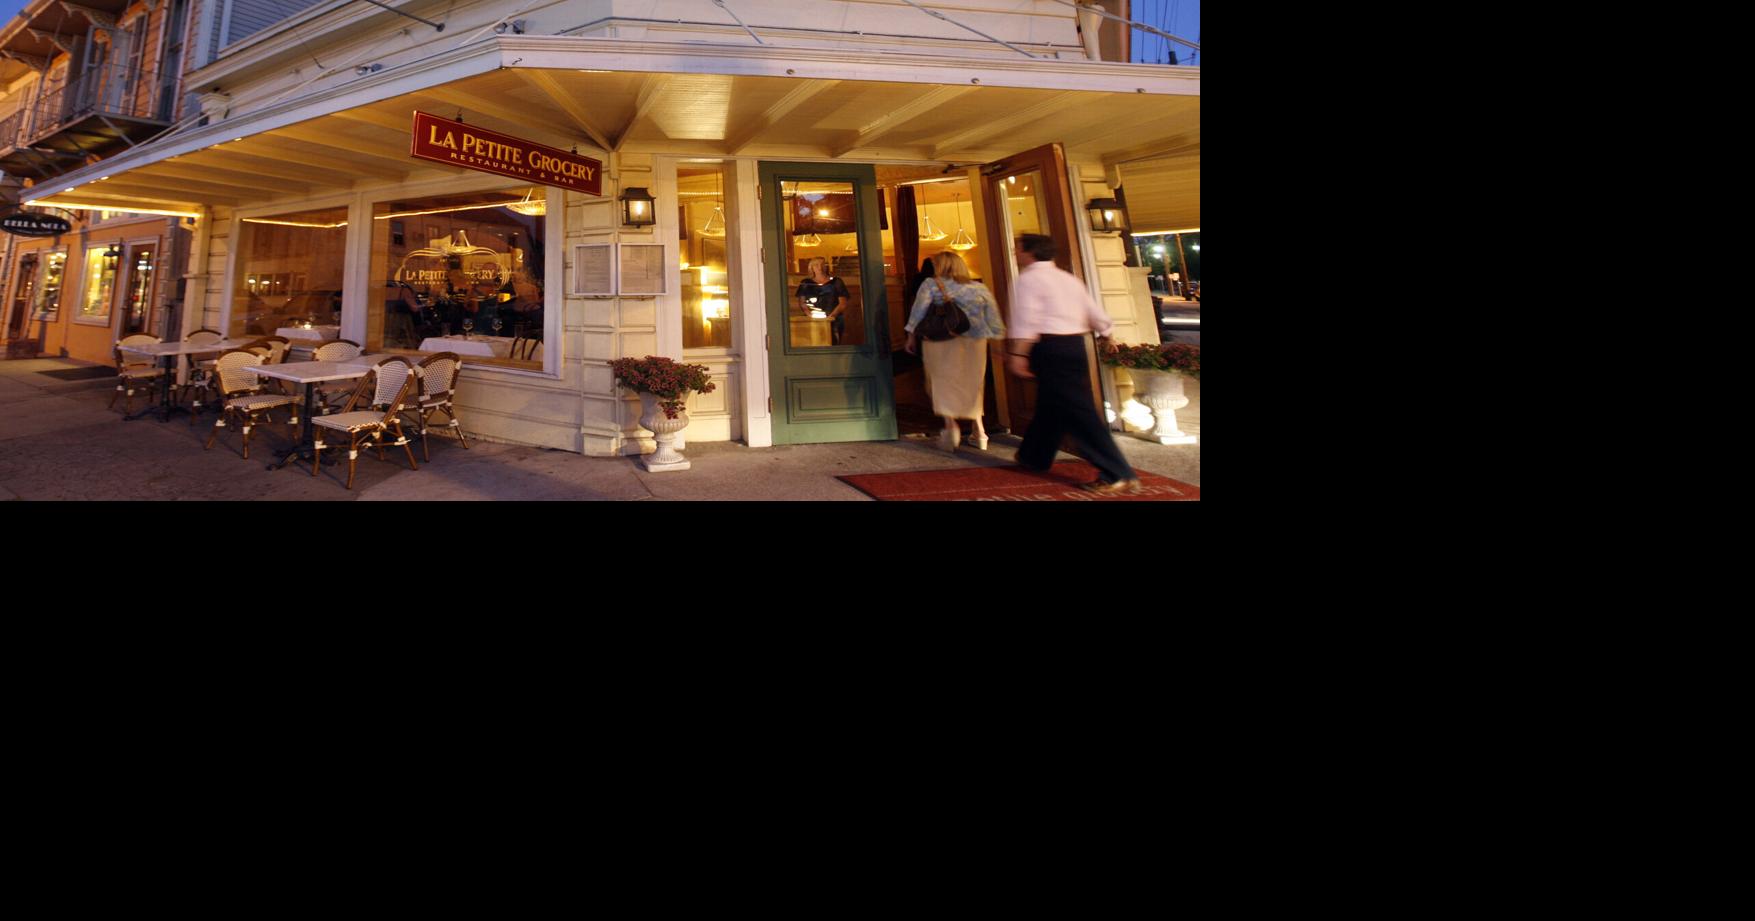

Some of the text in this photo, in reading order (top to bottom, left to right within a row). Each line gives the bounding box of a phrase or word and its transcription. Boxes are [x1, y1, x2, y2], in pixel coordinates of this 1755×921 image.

[429, 125, 595, 181] LA PETITE GROCERY
[450, 152, 531, 175] RESTAURANT
[554, 175, 574, 184] BAR
